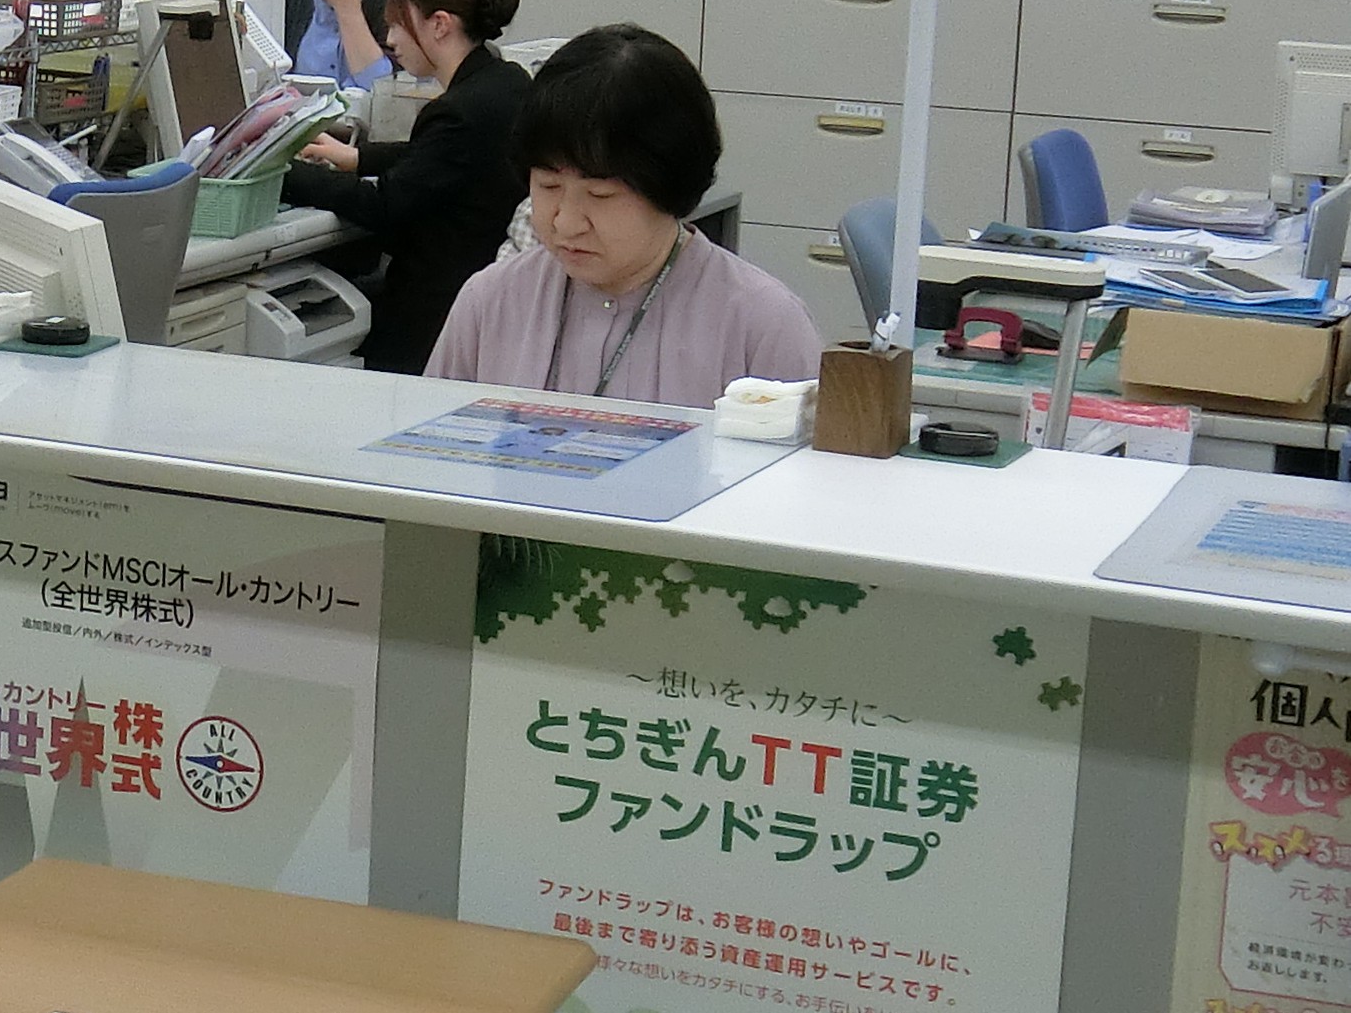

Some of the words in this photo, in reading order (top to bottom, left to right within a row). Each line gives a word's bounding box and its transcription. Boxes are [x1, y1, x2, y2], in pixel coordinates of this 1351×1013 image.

[40, 578, 195, 629] (全世界株式)
[208, 723, 237, 743] ALL
[1250, 678, 1351, 743] 個人
[184, 769, 256, 806] COUNTRY
[525, 699, 980, 824] とちぎんTT証券
[553, 774, 942, 882] ファンドラップ
[1289, 878, 1351, 910] 元本
[538, 877, 974, 978] ファンドラップは、お客様の想いやゴールに、
[553, 912, 959, 1007] 最後まで寄り添う資産運用サービスです。
